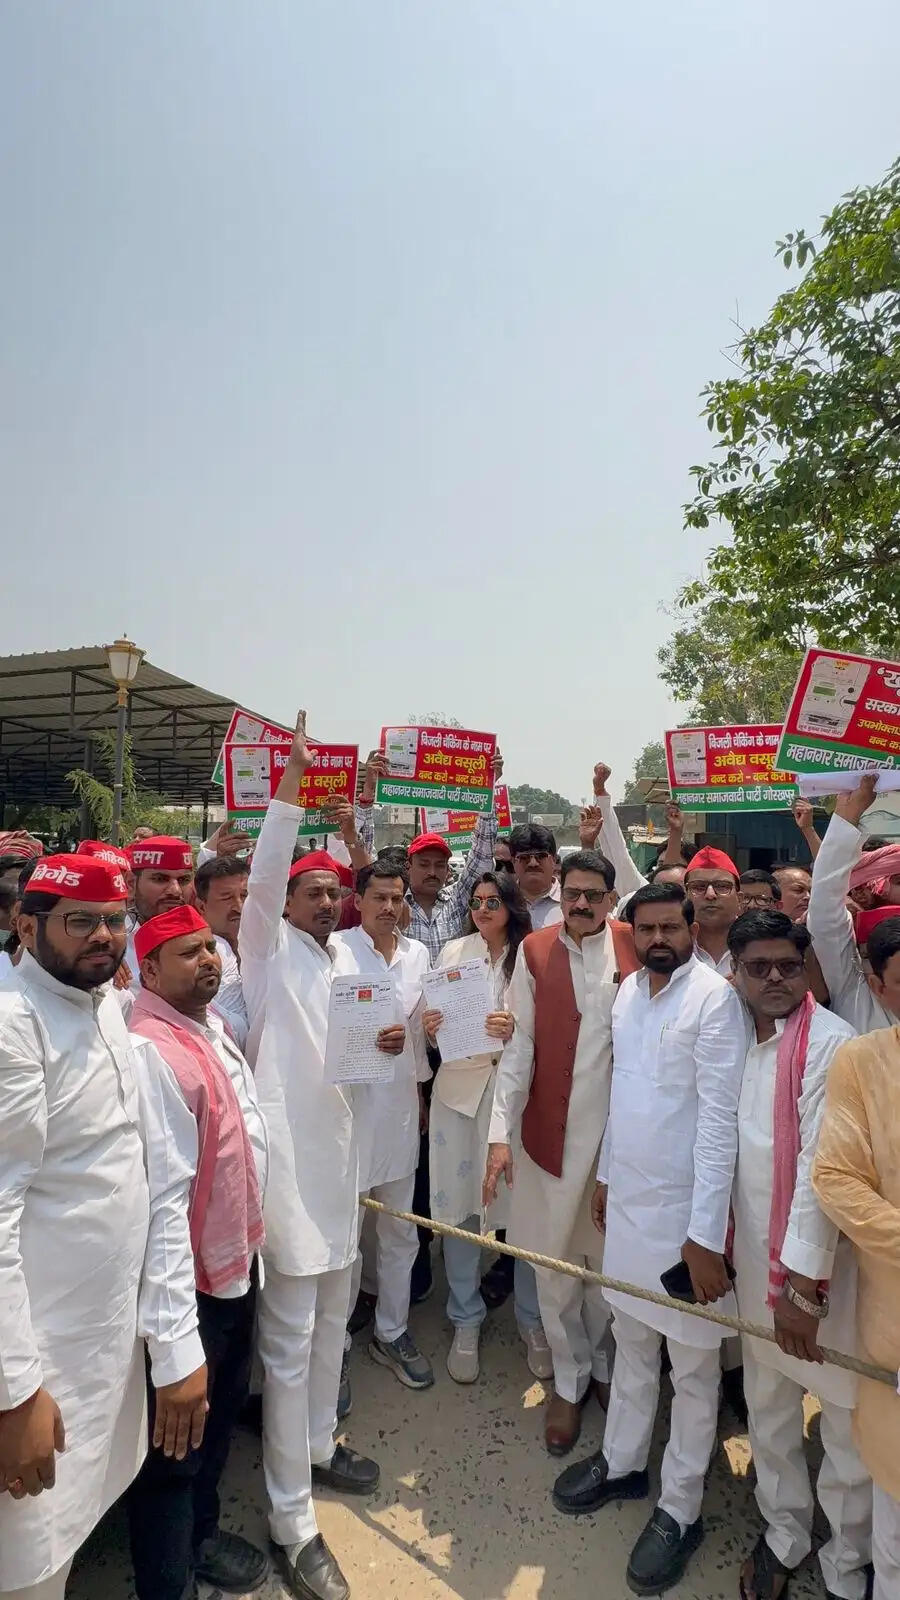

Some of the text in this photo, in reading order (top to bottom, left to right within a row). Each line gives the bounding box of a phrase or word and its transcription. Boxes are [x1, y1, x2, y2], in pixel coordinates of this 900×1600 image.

[462, 736, 471, 752] के
[471, 740, 483, 752] नाम
[483, 742, 492, 754] पर
[756, 731, 765, 747] के
[321, 752, 330, 768] के
[330, 755, 344, 768] नाम
[344, 756, 354, 768] पर
[786, 743, 834, 767] महानगर
[454, 755, 487, 774] वसूली
[314, 770, 348, 793] वसूली
[728, 770, 744, 783] करो
[382, 784, 411, 797] महानगर
[412, 785, 446, 800] समाजवादी
[447, 787, 460, 802] पार्टी
[461, 789, 489, 810] गोरखपुर
[676, 786, 795, 806] महानगर समाजवादी पार्टी गोरखपुर
[133, 850, 164, 865] सभा
